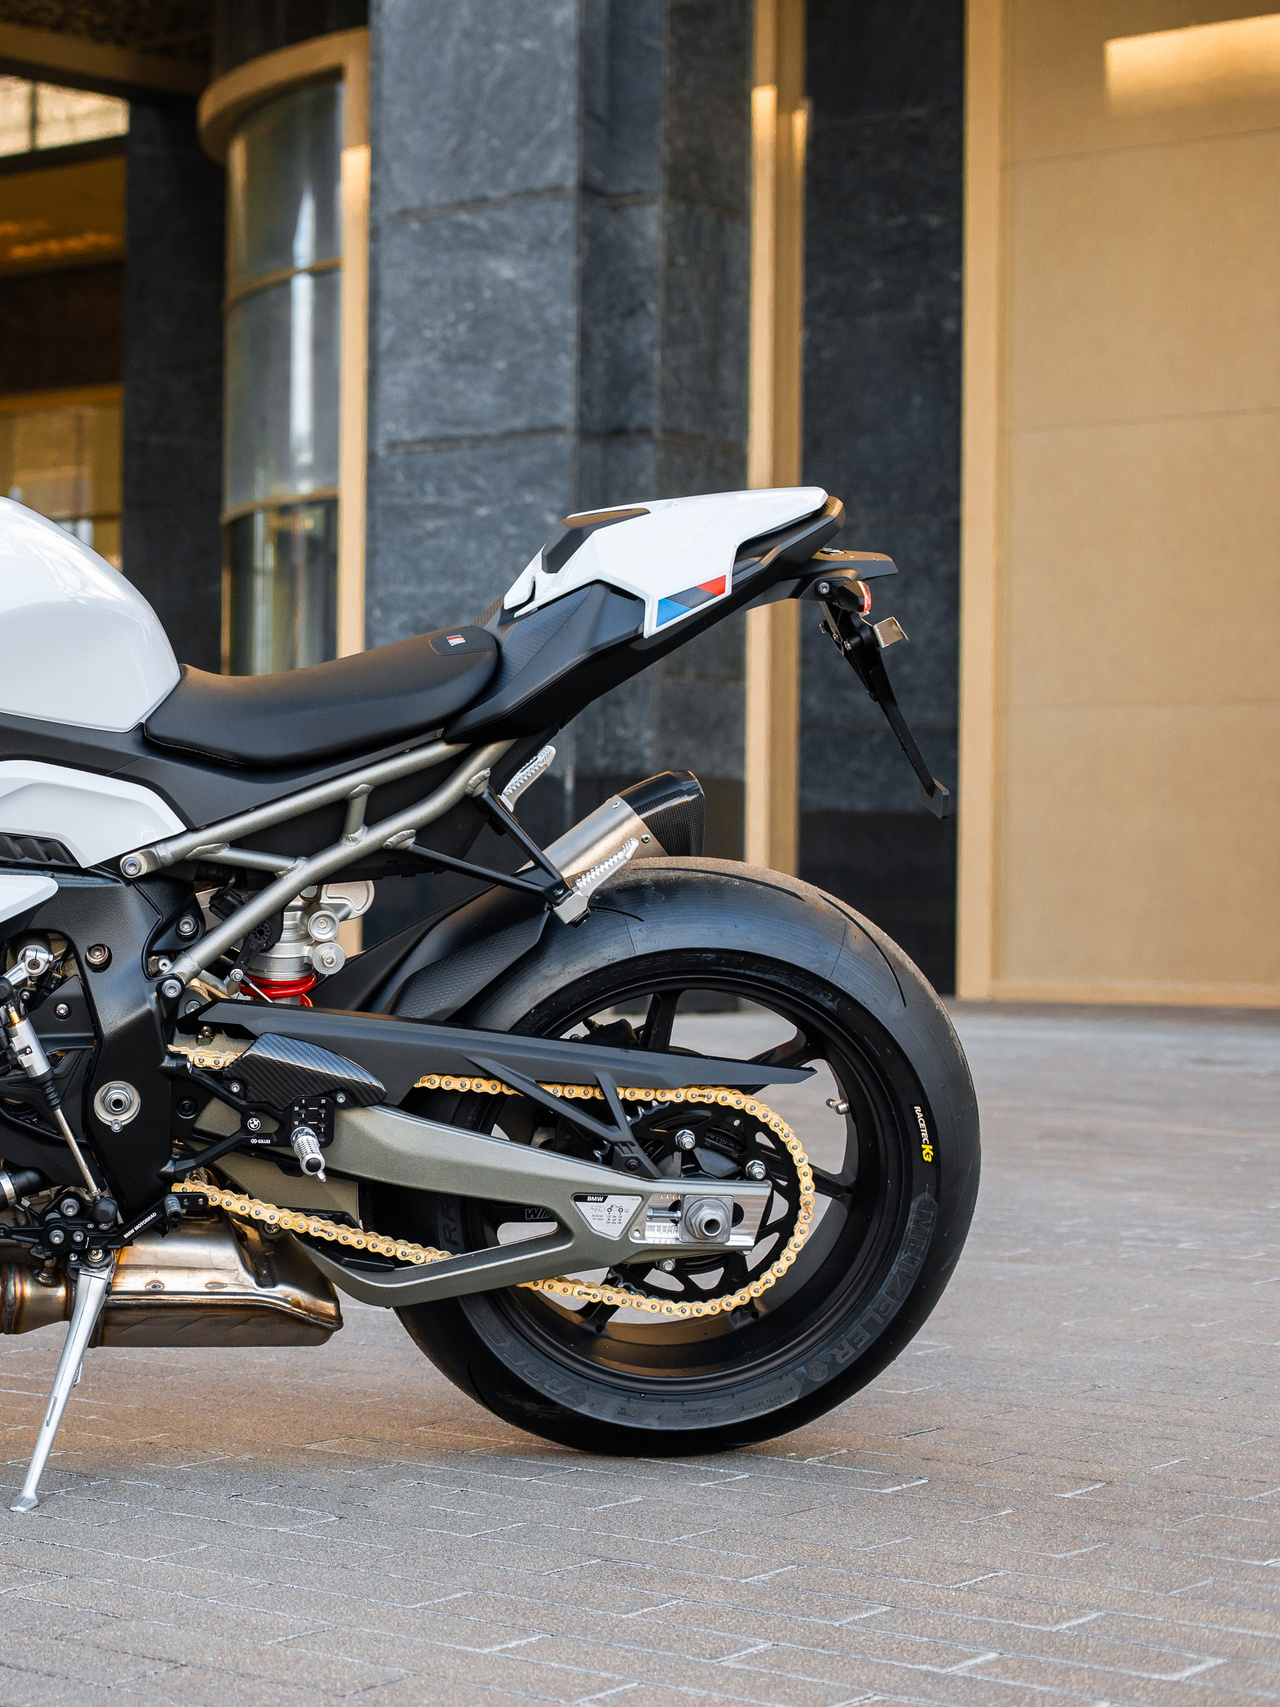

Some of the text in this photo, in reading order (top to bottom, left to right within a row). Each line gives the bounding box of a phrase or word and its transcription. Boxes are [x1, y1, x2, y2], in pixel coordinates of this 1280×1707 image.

[914, 1106, 935, 1162] RACETEC K3
[830, 1209, 934, 1364] METZELER
